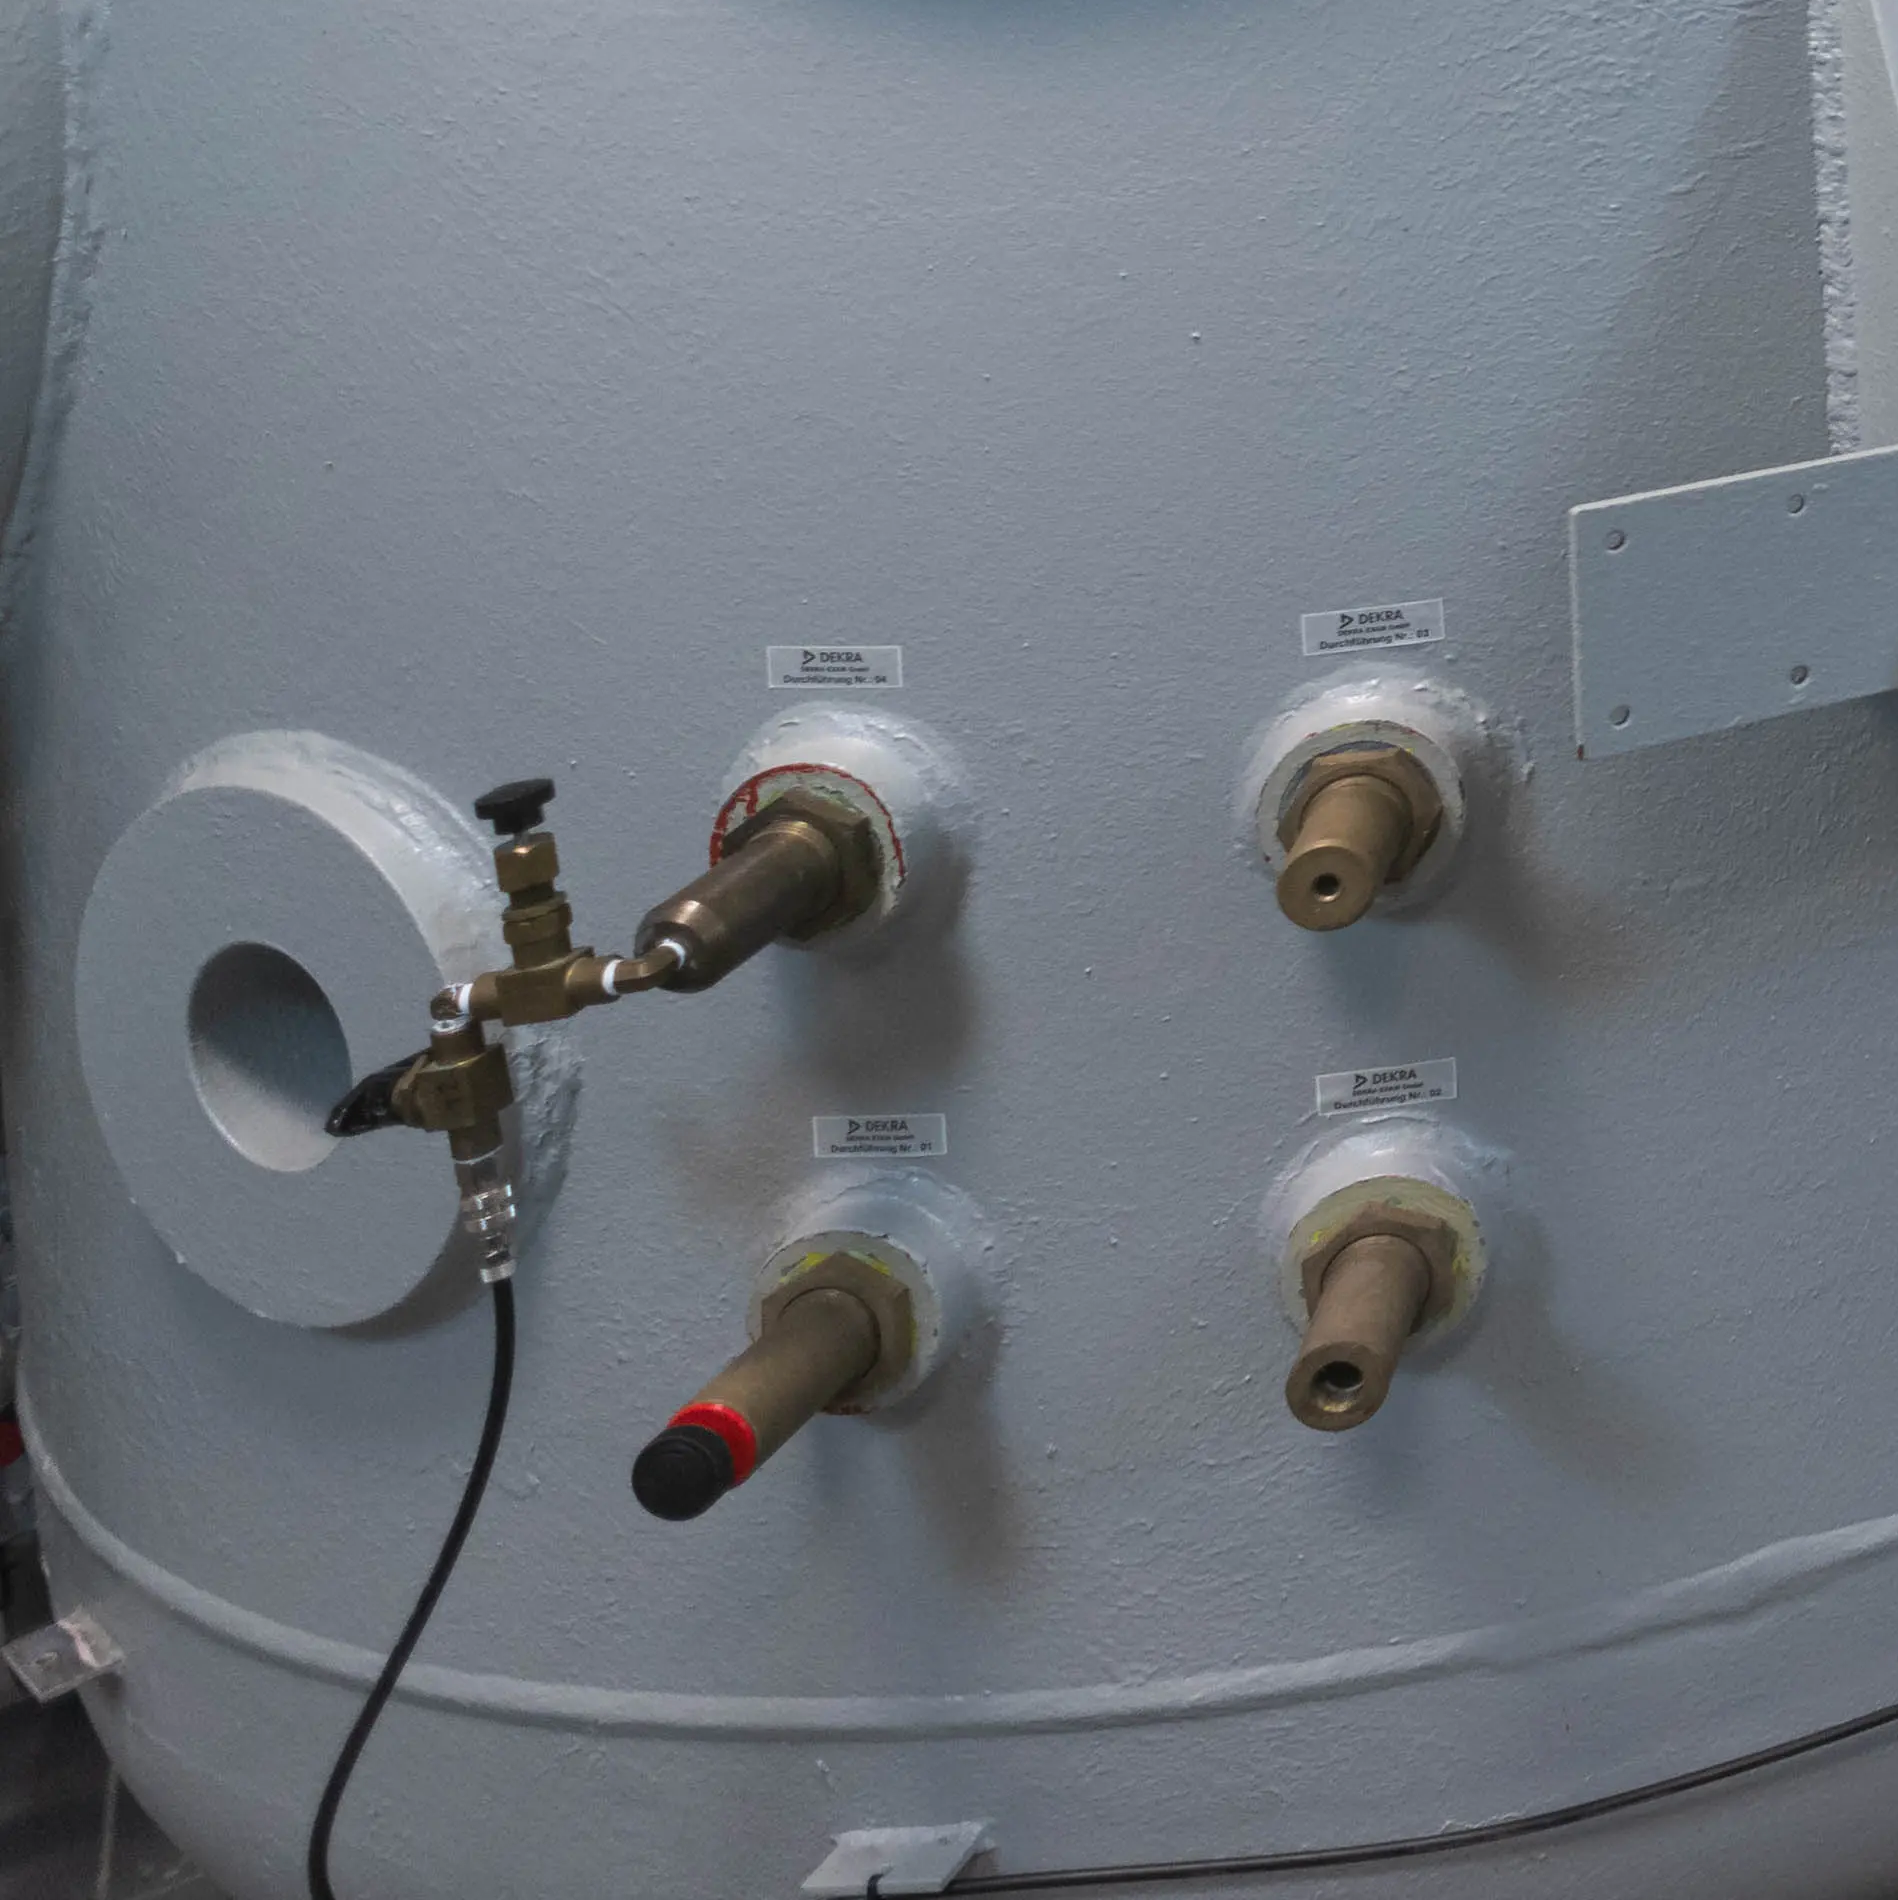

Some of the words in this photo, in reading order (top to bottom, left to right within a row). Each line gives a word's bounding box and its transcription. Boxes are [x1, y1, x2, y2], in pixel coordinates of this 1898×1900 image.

[1358, 609, 1405, 625] DEKRA
[819, 652, 863, 662] DEKRA
[1372, 1069, 1418, 1085] DEKRA
[866, 1120, 909, 1132] DEKRA
